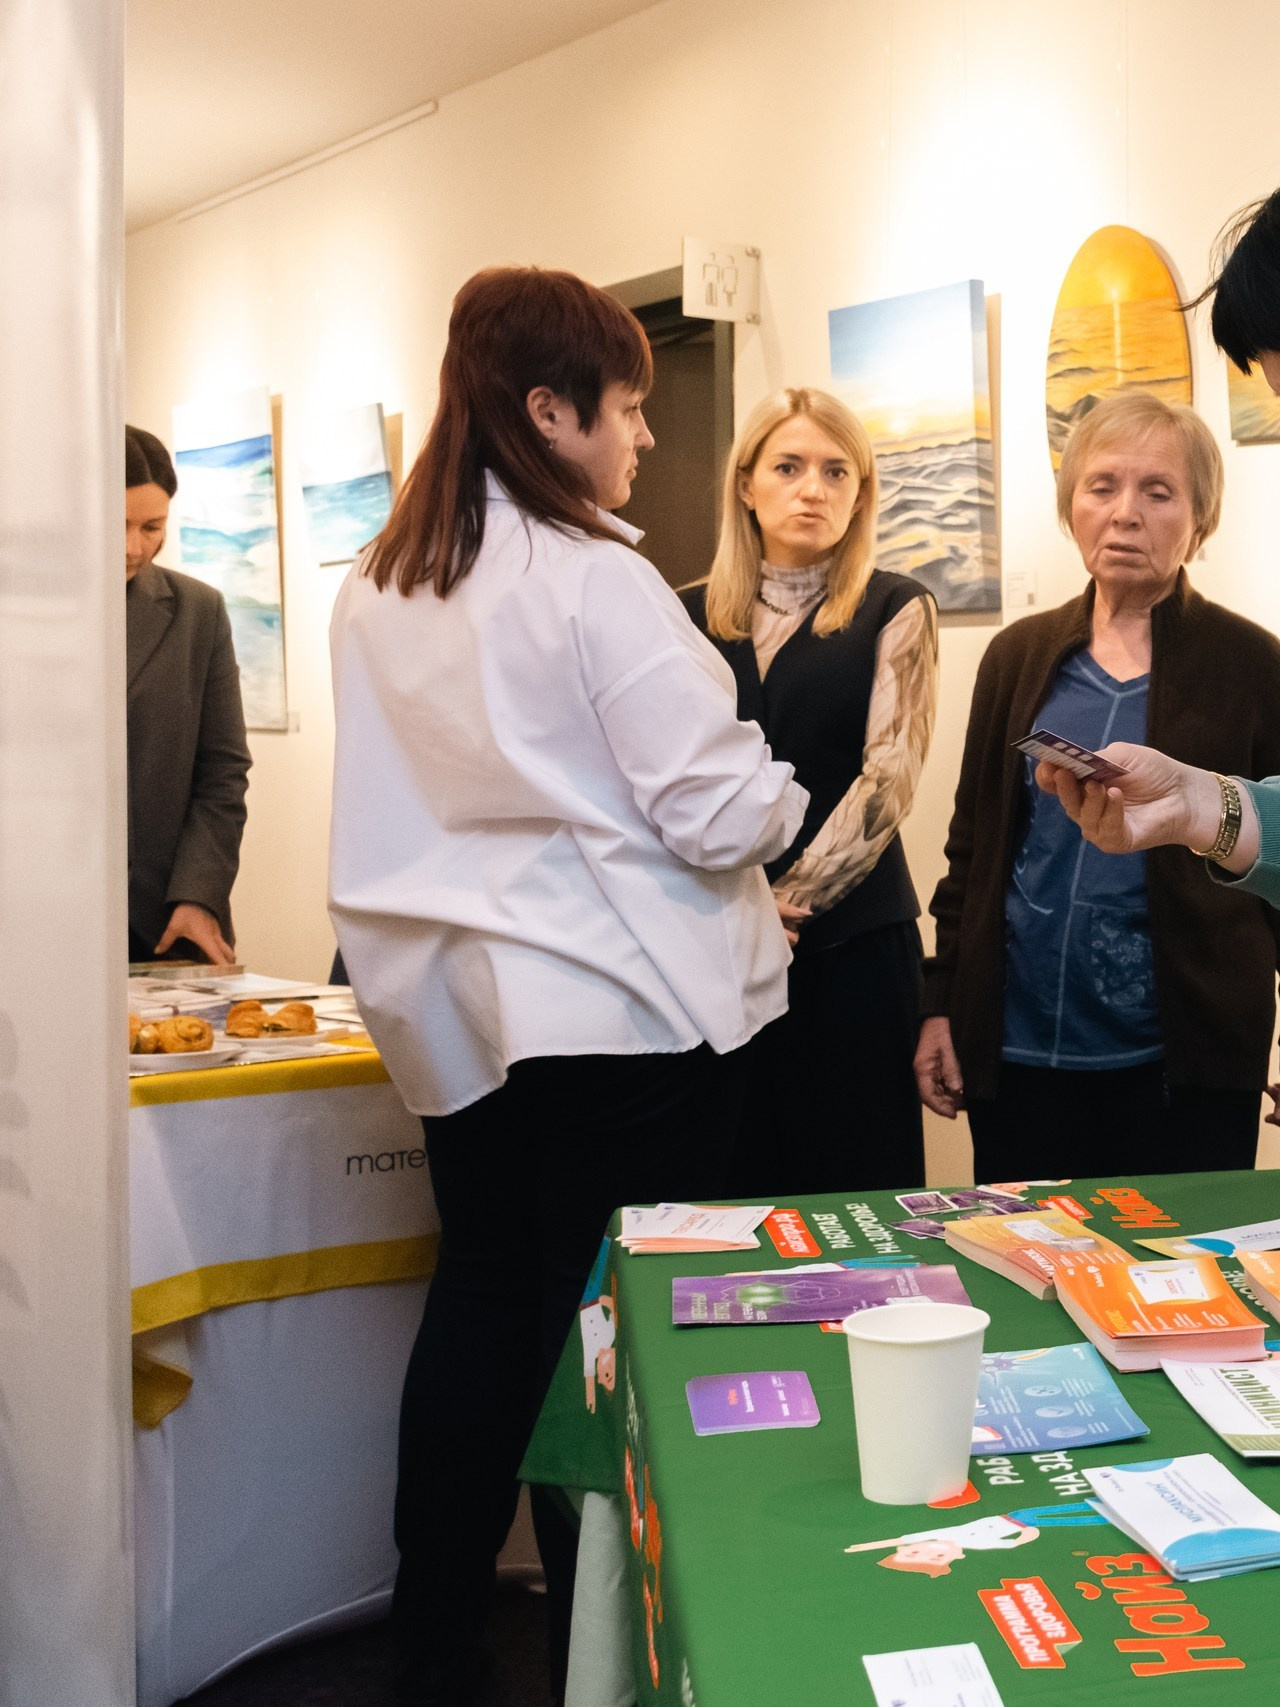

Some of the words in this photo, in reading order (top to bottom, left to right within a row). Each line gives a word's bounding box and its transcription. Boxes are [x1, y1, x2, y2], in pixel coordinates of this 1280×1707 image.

[811, 1211, 856, 1249] РАБОТАЕТ
[882, 1233, 903, 1254] НА
[1048, 1467, 1093, 1497] НА
[993, 1593, 1052, 1664] ПРОГРАММА
[1014, 1582, 1068, 1640] ЗДОРОВЬЯ
